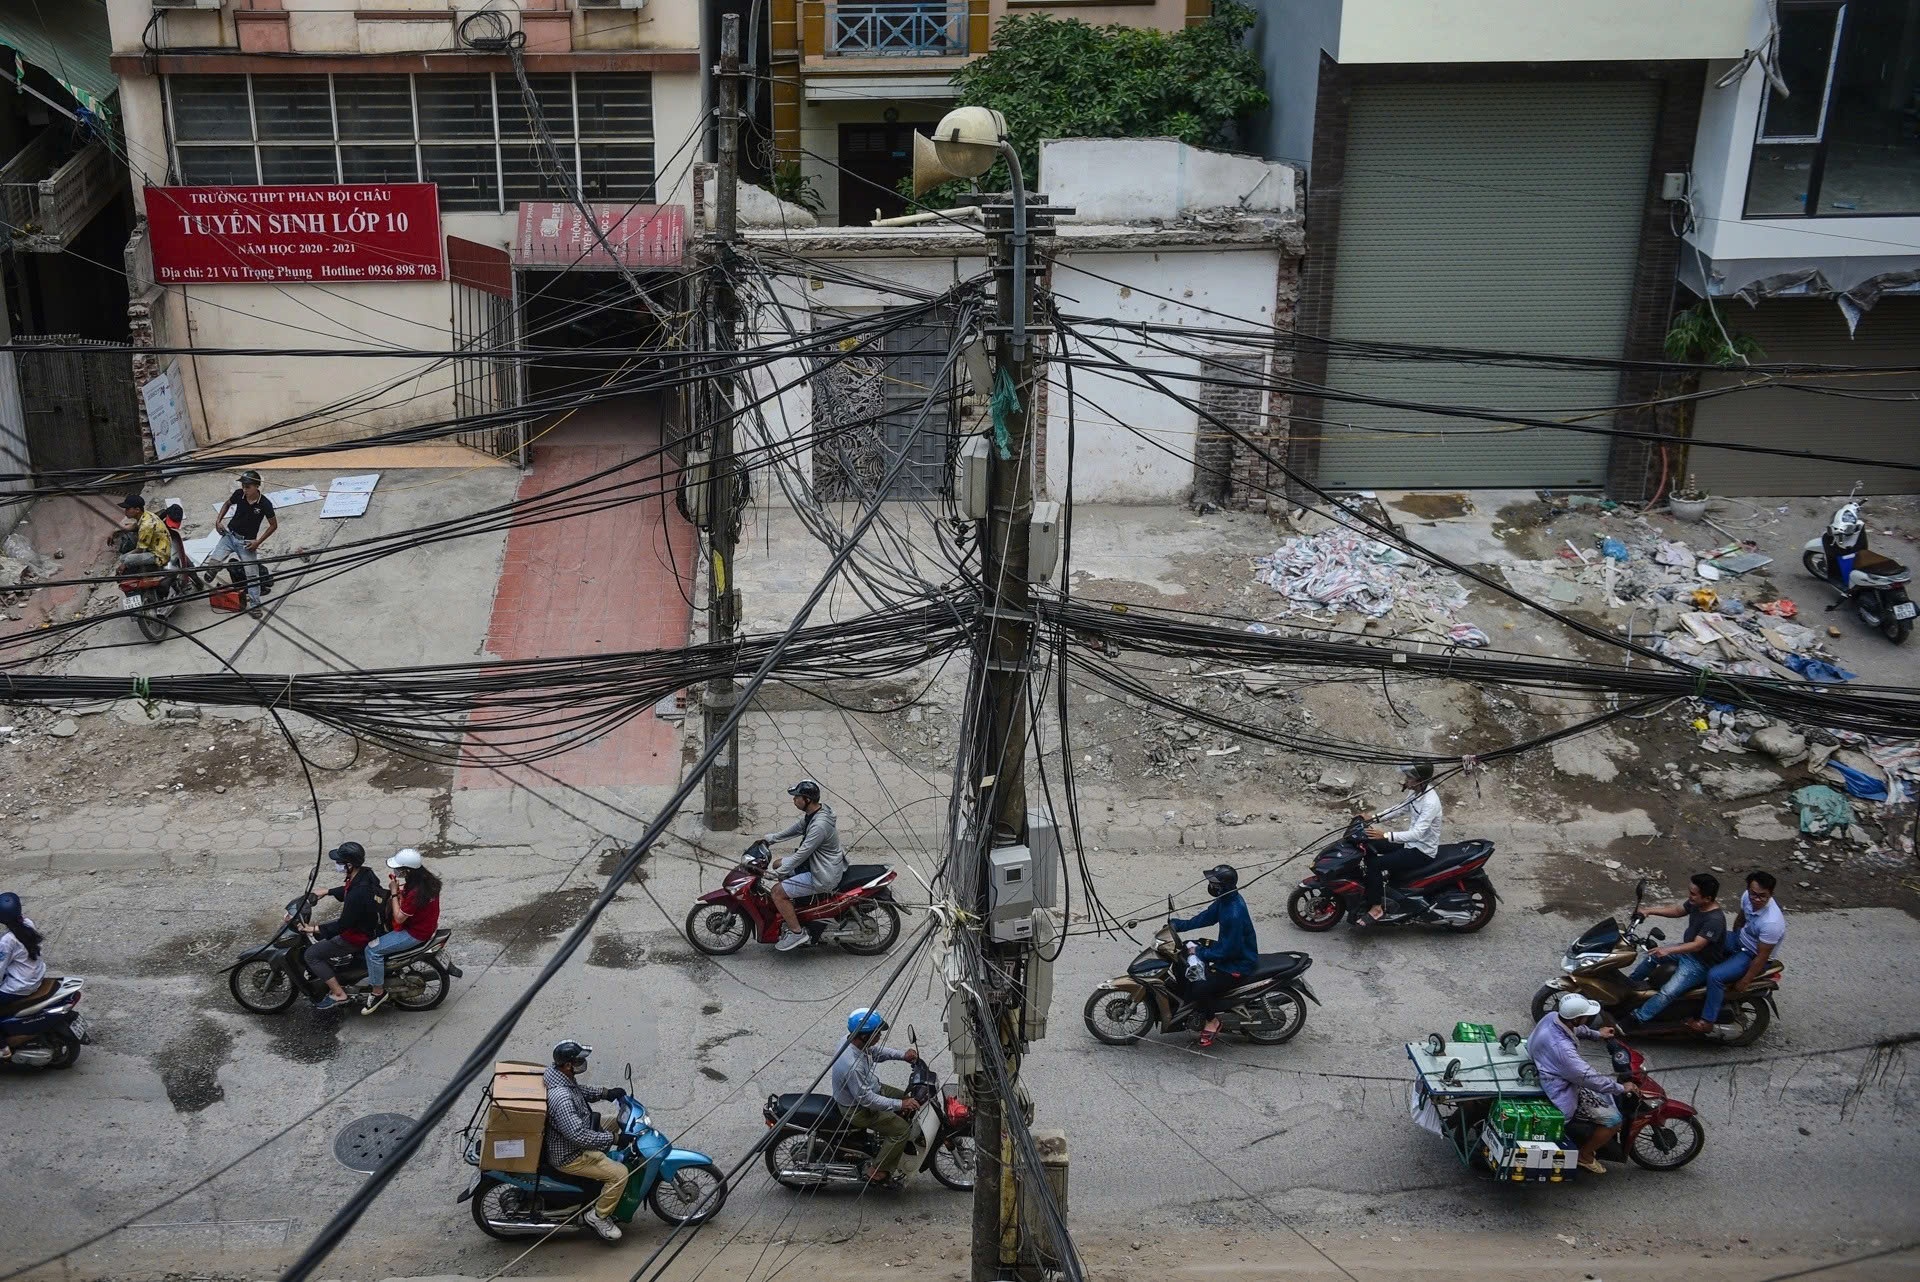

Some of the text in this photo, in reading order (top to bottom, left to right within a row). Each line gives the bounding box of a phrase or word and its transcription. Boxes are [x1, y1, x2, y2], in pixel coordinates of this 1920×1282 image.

[189, 188, 391, 204] TRƯỜNG THPT PHAN BỘI CHÂU
[178, 207, 409, 235] TUYỂN SINH LỚP 10
[238, 244, 266, 254] NĂM
[269, 244, 297, 256] HỌC
[299, 243, 323, 253] 2020
[333, 243, 356, 253] 2021
[161, 267, 181, 280] Địa
[207, 267, 219, 278] 21
[222, 266, 238, 278] Vũ
[241, 266, 275, 280] Trọng
[277, 266, 313, 280] Phụng
[321, 265, 365, 277] Hotline:
[368, 264, 393, 276] 0936
[396, 264, 415, 275] 898
[417, 264, 437, 275] 703
